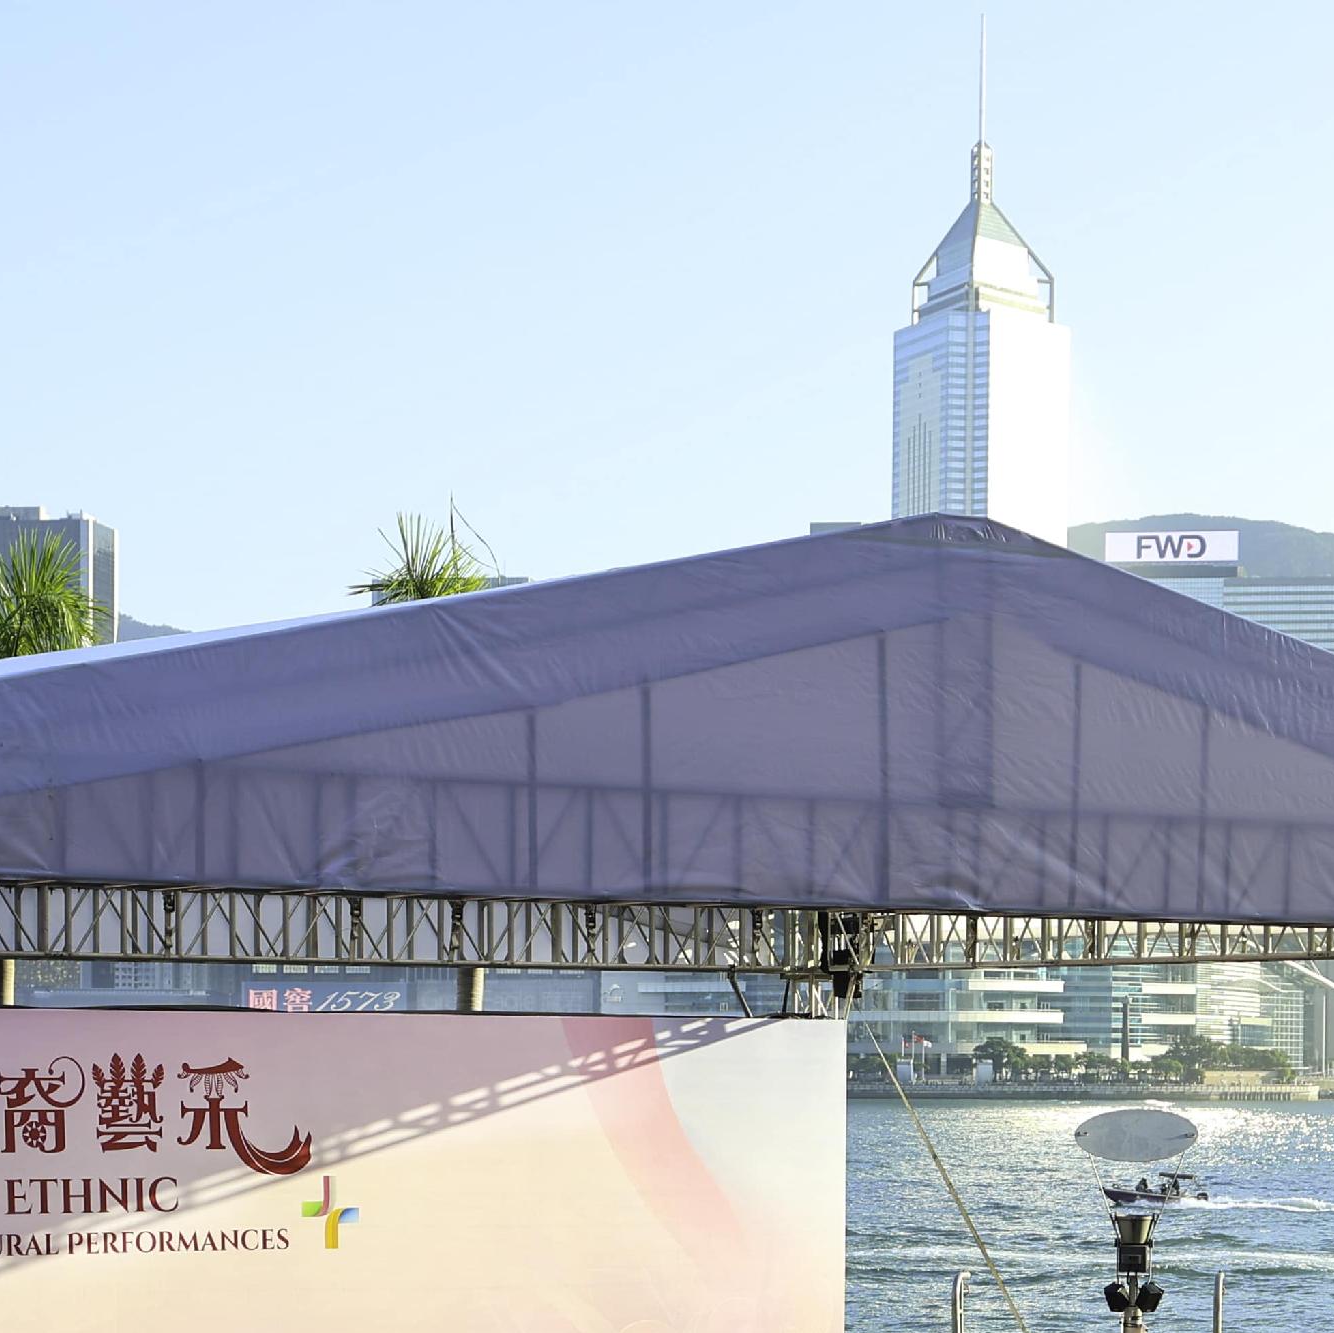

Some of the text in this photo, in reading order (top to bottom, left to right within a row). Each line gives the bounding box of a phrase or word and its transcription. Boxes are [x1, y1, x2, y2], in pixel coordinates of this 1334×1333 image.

[1136, 535, 1207, 559] FWD
[5, 1177, 179, 1215] ETHNIC
[68, 1228, 290, 1255] PERFORMANCES
